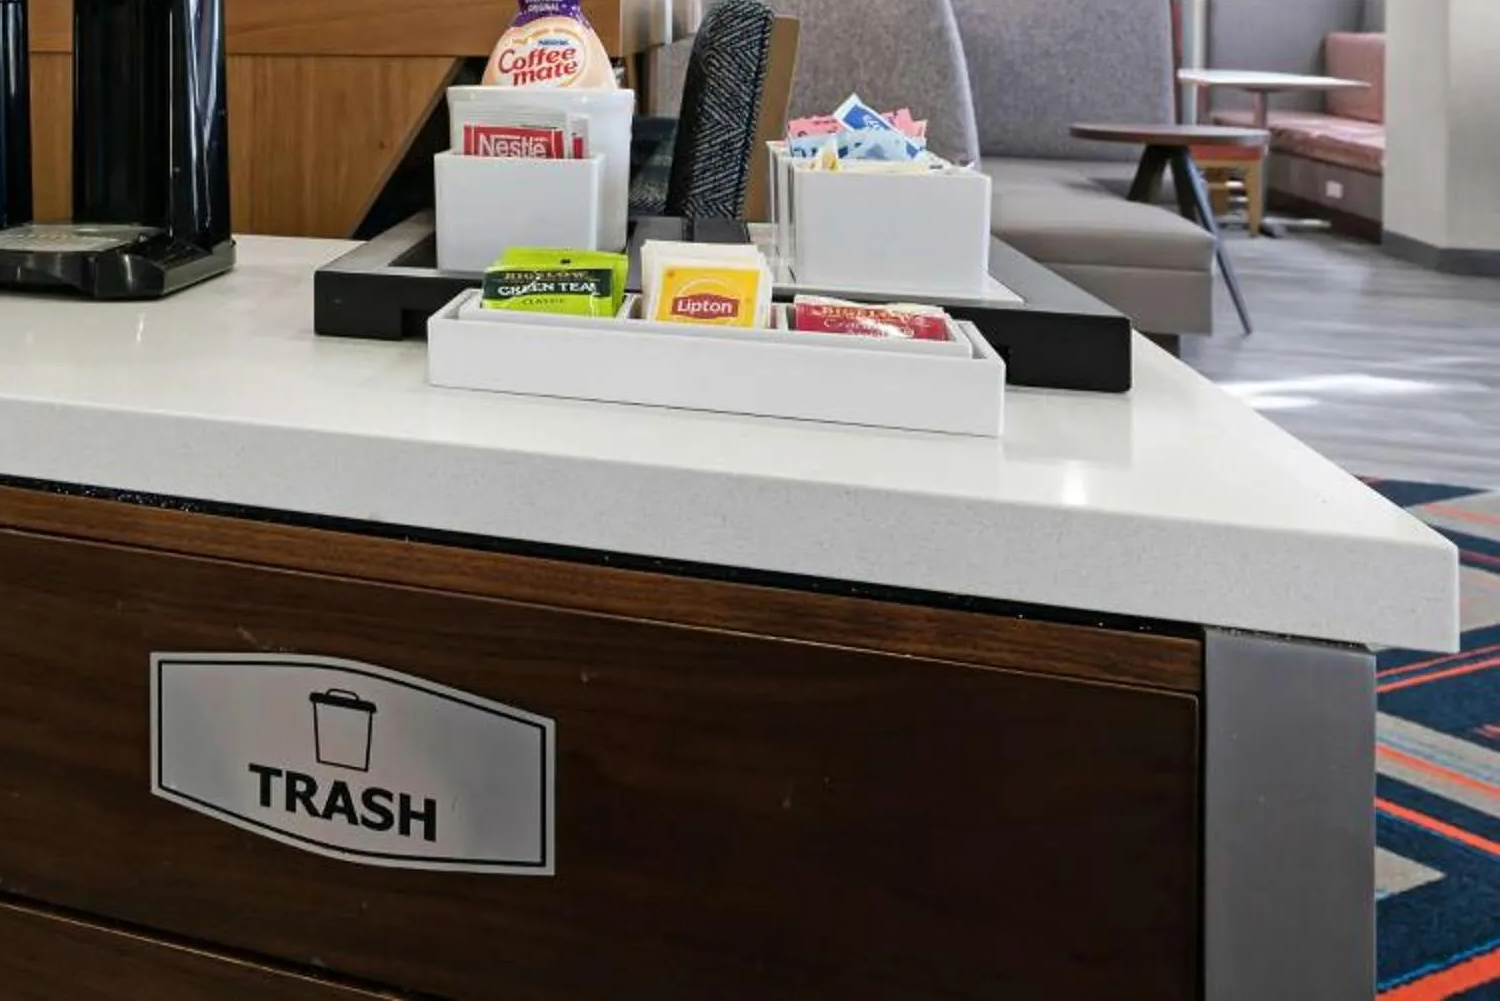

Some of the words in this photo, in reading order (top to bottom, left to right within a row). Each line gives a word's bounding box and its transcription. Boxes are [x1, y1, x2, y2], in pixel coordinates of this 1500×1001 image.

[498, 48, 577, 74] Coffee
[512, 61, 578, 86] mate
[676, 299, 733, 315] Lipton
[248, 762, 438, 842] TRASH
